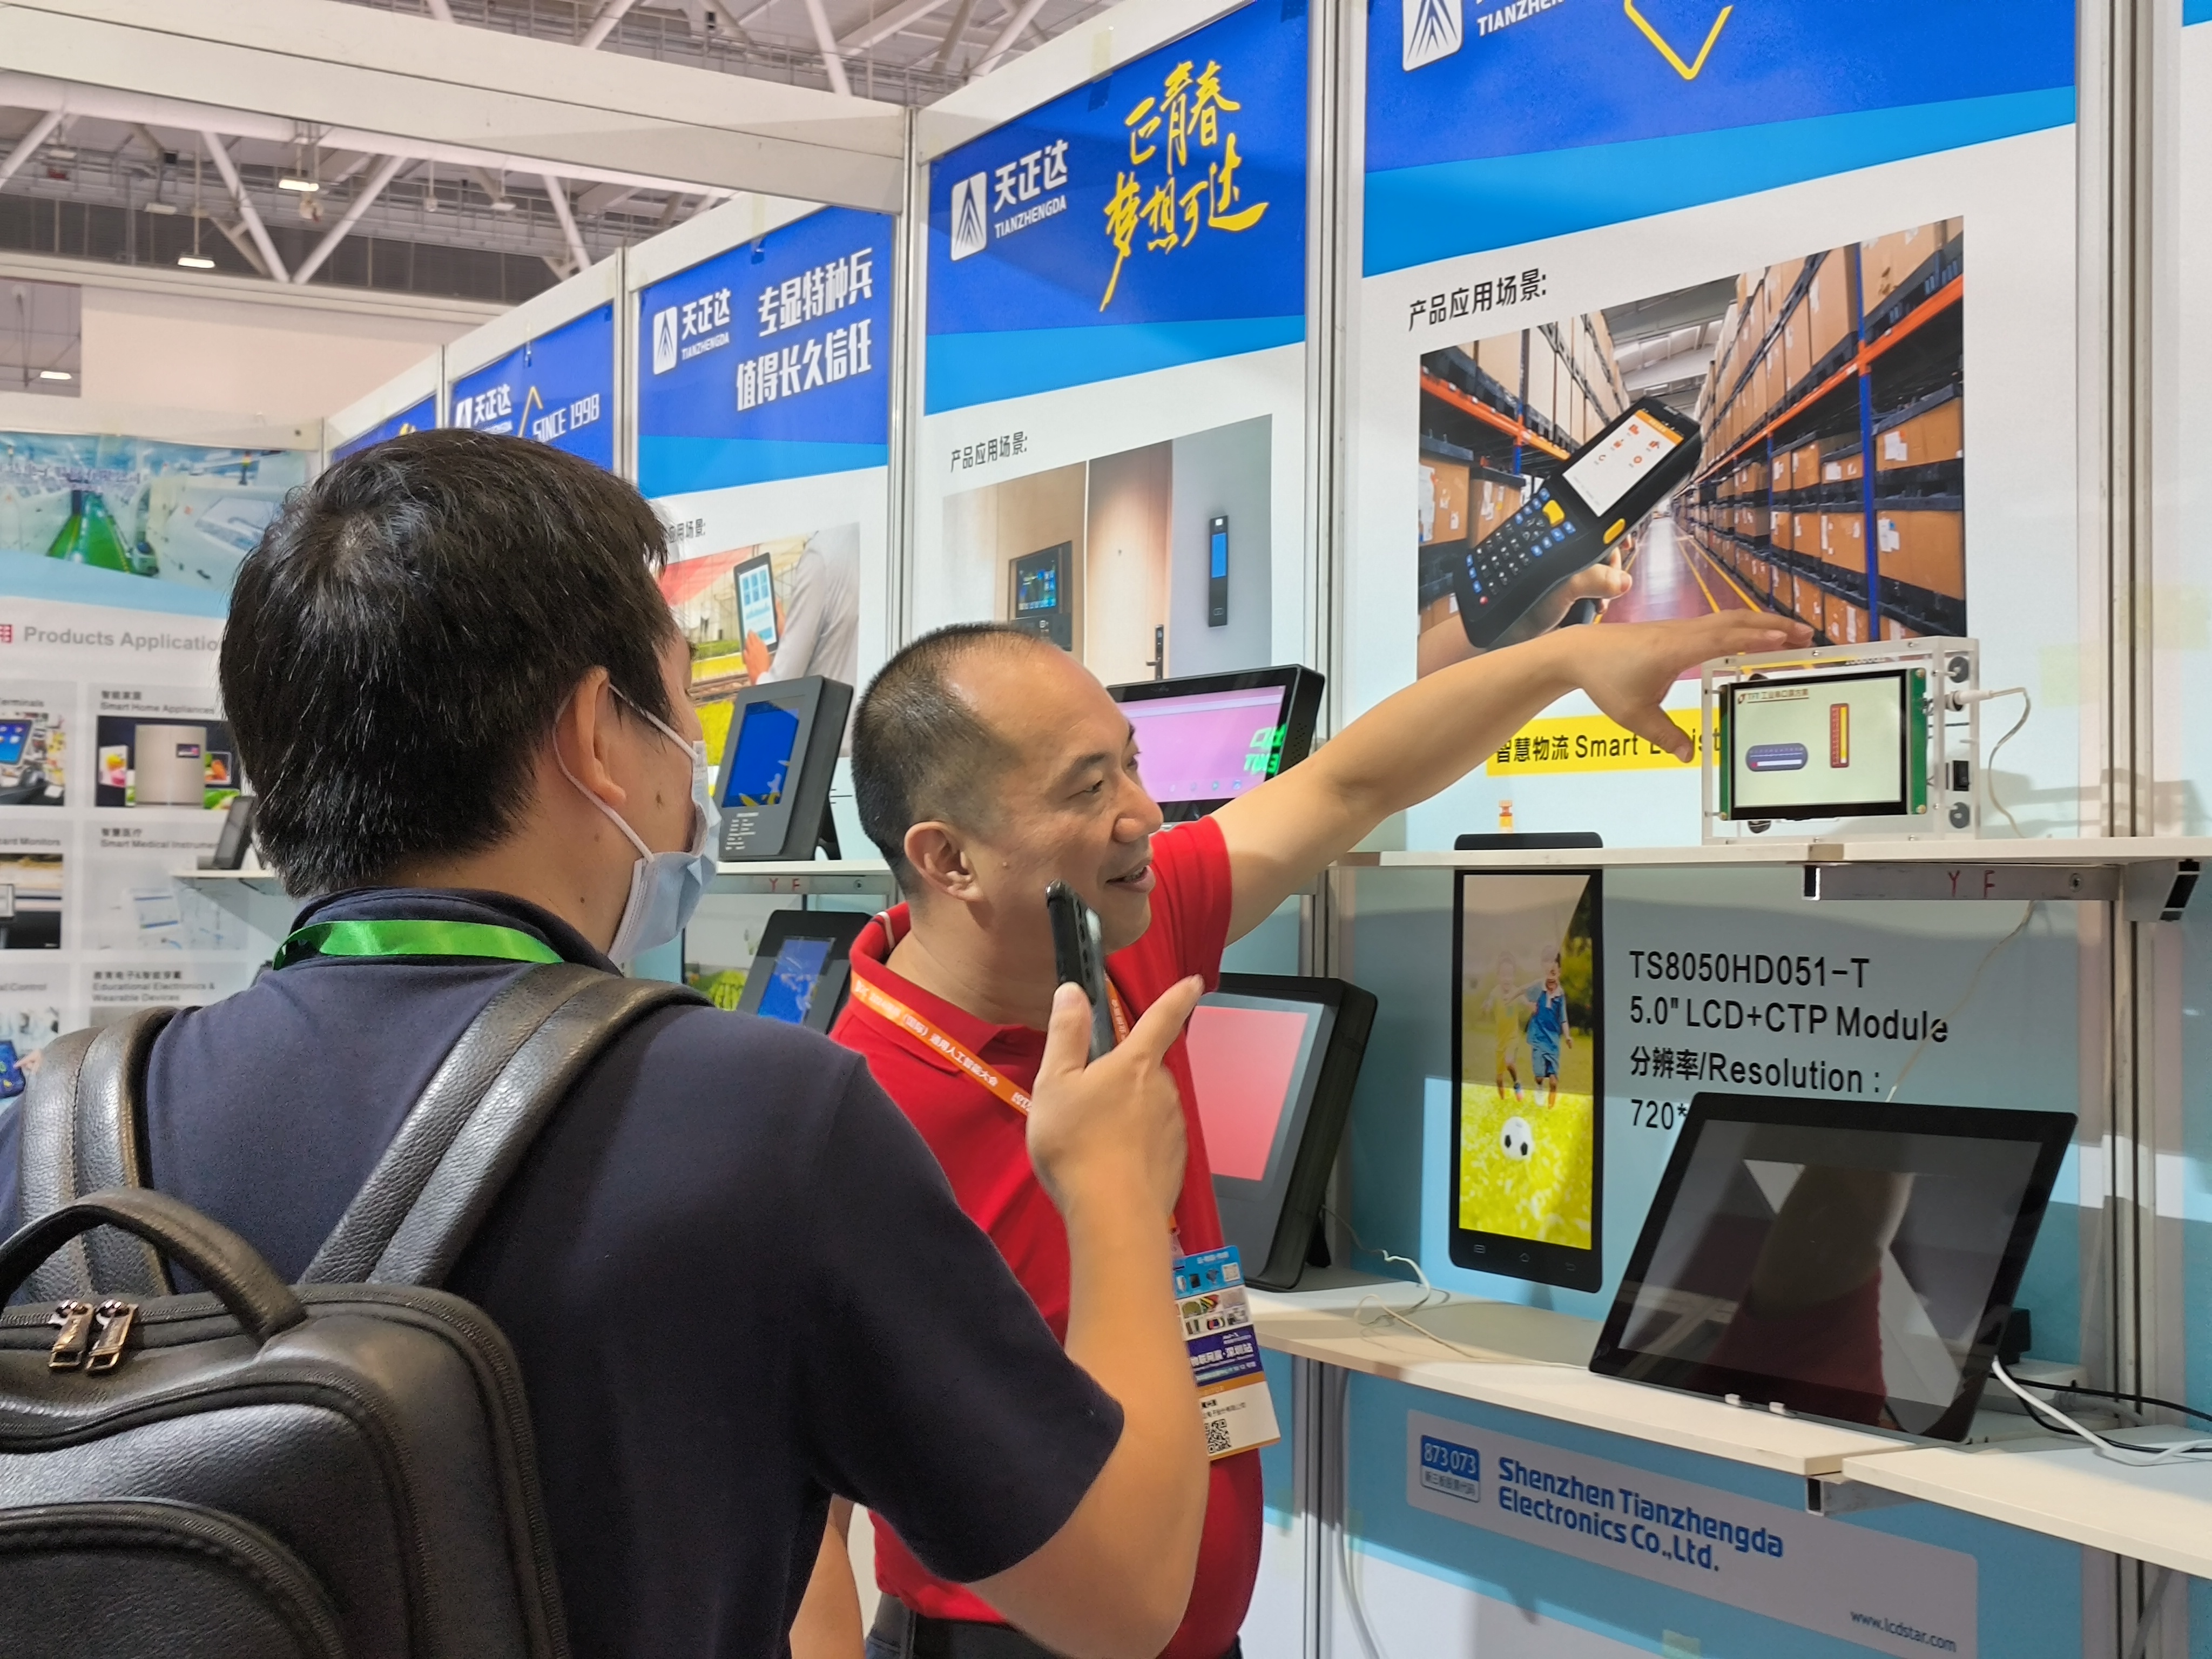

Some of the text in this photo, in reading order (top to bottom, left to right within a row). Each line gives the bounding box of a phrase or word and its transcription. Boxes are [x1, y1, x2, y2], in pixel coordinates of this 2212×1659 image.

[994, 139, 1069, 213] 天正达
[994, 195, 1067, 239] TIANZHENGDA
[1099, 132, 1269, 312] 梦想可达
[758, 247, 872, 337] 专显特种兵
[1408, 268, 1547, 332] 产品应用场景:
[682, 288, 731, 340] 天正达
[682, 332, 730, 360] TIANZHENGDA
[737, 319, 872, 412] 值得长久信任
[474, 383, 512, 426] 天正达
[532, 393, 600, 443] SINCE 1998
[950, 431, 1028, 473] 产品应用场景:
[24, 626, 114, 646] Products
[120, 631, 220, 651] Applicatio
[1575, 733, 1638, 758] Smart
[768, 878, 801, 892] Y F
[1948, 869, 1996, 898] Y F
[1629, 950, 1870, 988] TS8050HD051-T
[1837, 1006, 1949, 1043] Module
[1499, 1456, 1783, 1558] Shenzhen Tianzhengda
[1499, 1486, 1627, 1544] Electronics
[1850, 1611, 1957, 1653] www.lcdstar.com
